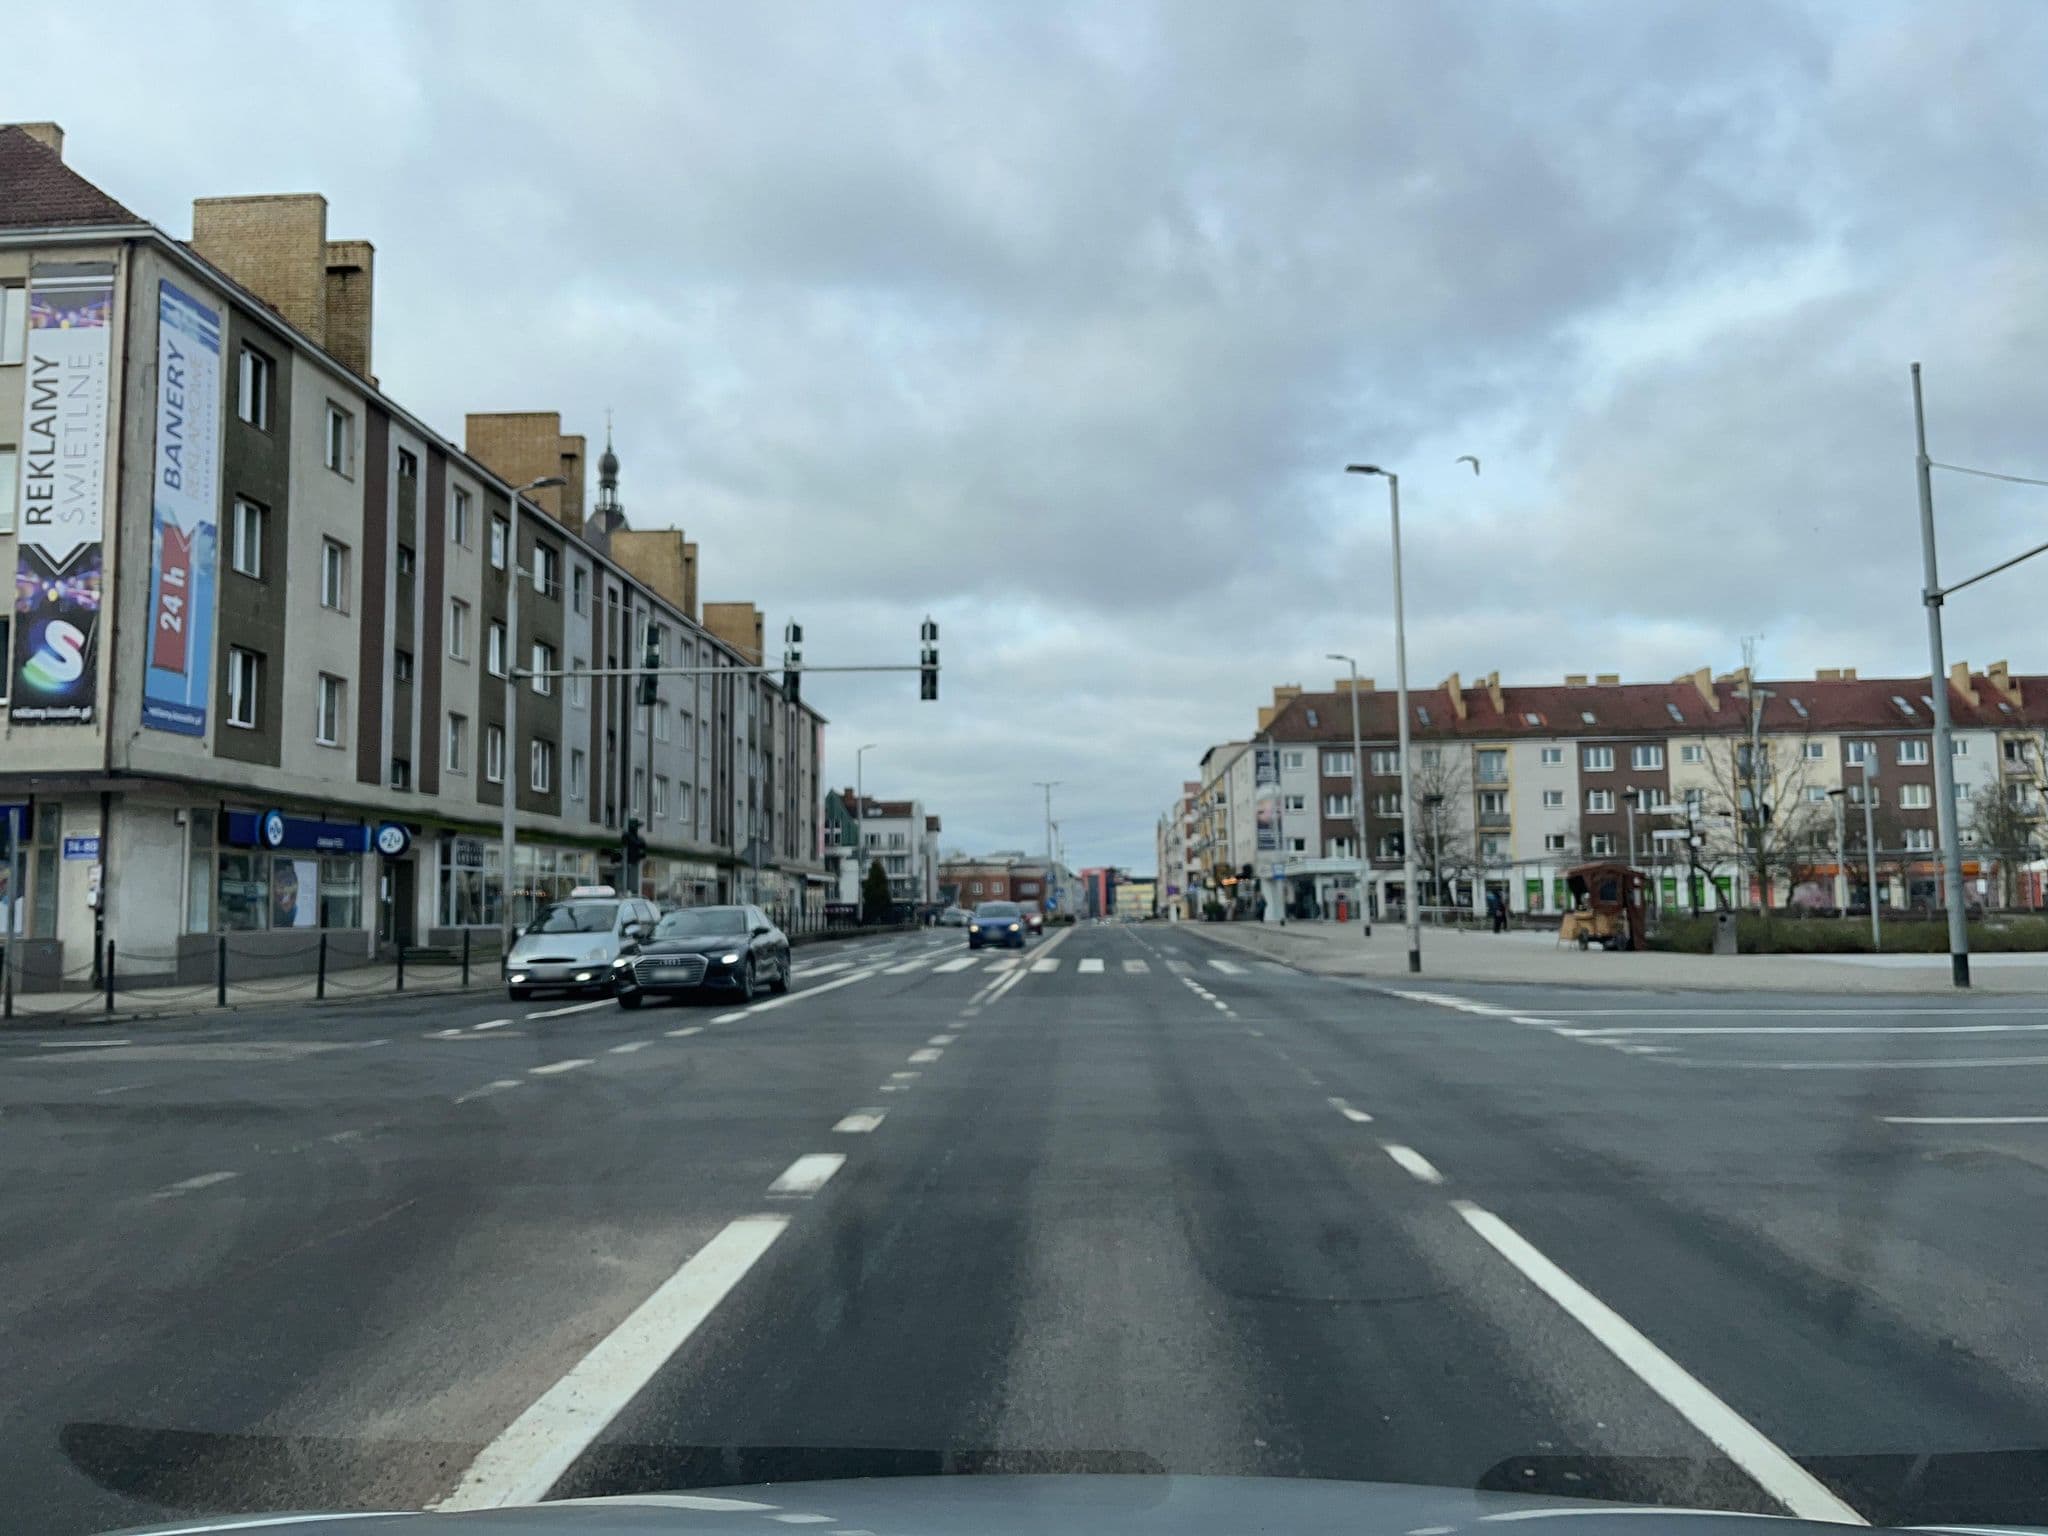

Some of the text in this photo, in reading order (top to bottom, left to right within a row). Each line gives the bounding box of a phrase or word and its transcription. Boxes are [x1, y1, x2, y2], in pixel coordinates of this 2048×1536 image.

[26, 355, 60, 525] REKLAMY
[60, 353, 94, 526] ŚWIETLNE
[163, 340, 187, 491] BANERY
[160, 565, 187, 633] 24 h
